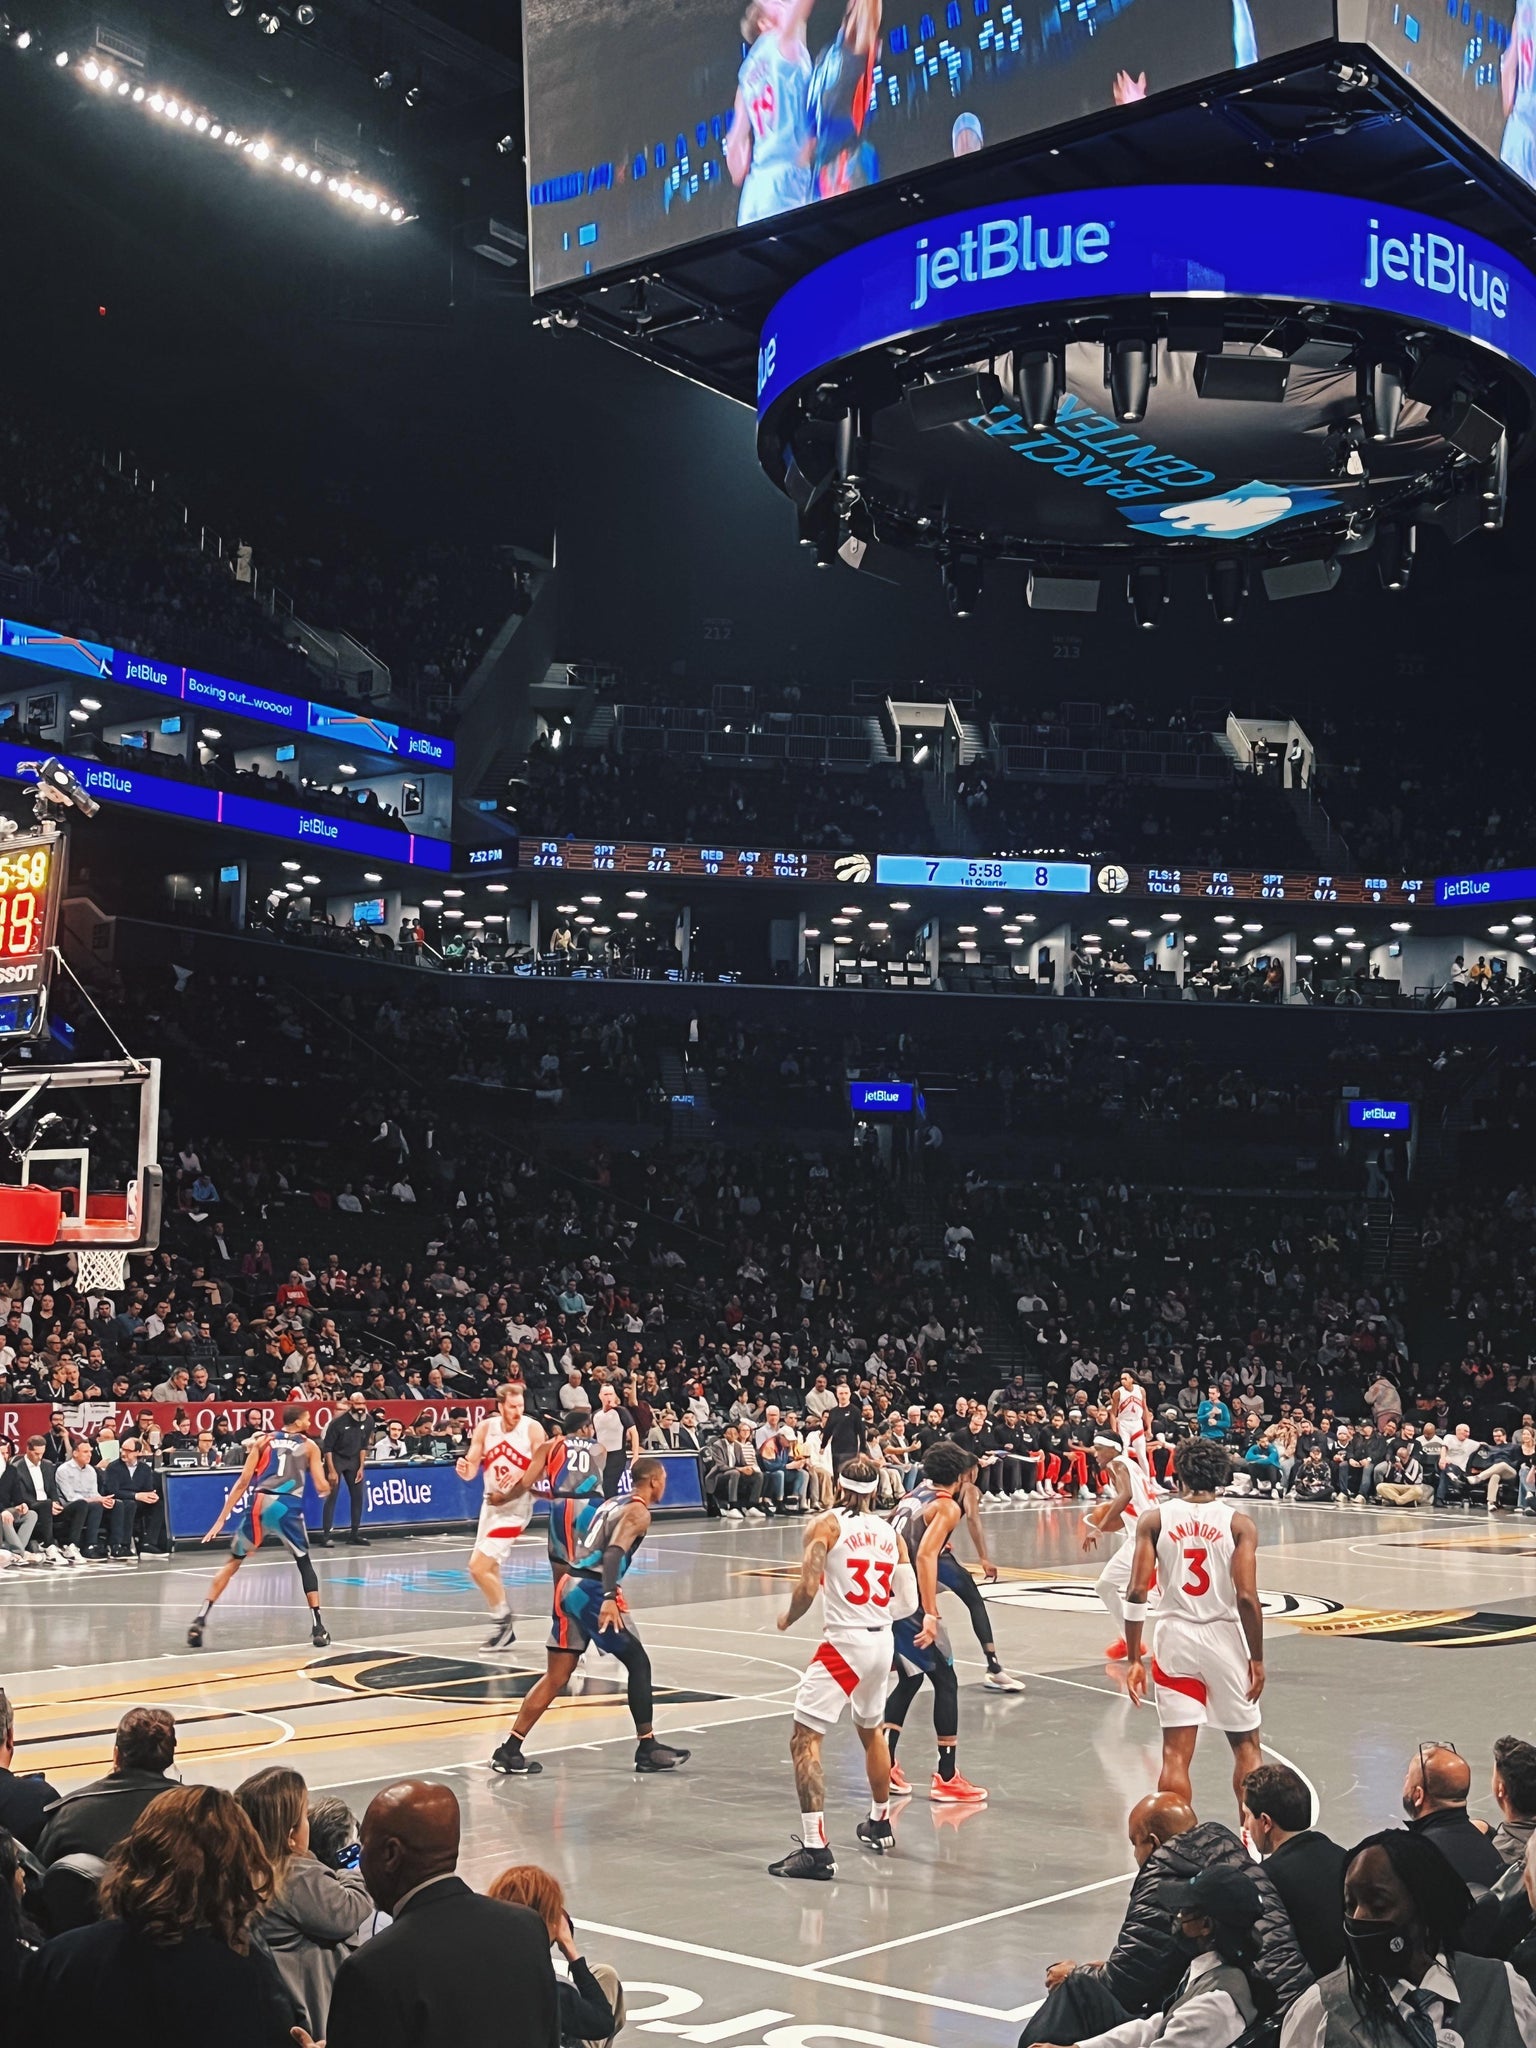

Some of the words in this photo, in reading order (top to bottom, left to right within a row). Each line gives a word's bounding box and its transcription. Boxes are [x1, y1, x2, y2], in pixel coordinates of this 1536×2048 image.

[910, 215, 1111, 310] jetBlue
[1363, 218, 1507, 319] jetBlue
[125, 660, 168, 685] jetBlue
[188, 677, 227, 702] Boxing
[408, 736, 443, 758] jetBlue
[85, 767, 133, 793] jetBlue
[298, 815, 339, 838] jetBlue
[488, 848, 503, 861] PM
[541, 842, 558, 853] FG
[594, 845, 616, 855] 3PT
[652, 847, 666, 857] FT
[700, 849, 724, 860] REB
[738, 851, 761, 862] AST
[705, 863, 719, 874] 10
[745, 864, 754, 876] 2
[925, 861, 941, 882] 7
[968, 863, 1003, 878] 5:58
[1034, 866, 1049, 887] 8
[960, 878, 973, 886] 1st
[974, 878, 1008, 888] Quarter
[1212, 872, 1228, 883] FG
[1262, 874, 1284, 885] 3PT
[1318, 876, 1333, 887] FT
[1364, 879, 1388, 889] REB
[1401, 880, 1424, 891] AST
[1443, 880, 1491, 901] jetBlue
[1205, 885, 1235, 896] 4/12
[1407, 893, 1416, 904] 4
[864, 1089, 900, 1104] jetBlue
[1362, 1107, 1397, 1121] jetBlue
[277, 1453, 287, 1477] 1
[566, 1449, 590, 1473] 20
[365, 1478, 432, 1512] jetBlue
[842, 1531, 878, 1552] TRENT
[844, 1558, 895, 1608] 33
[1181, 1548, 1211, 1597] 3
